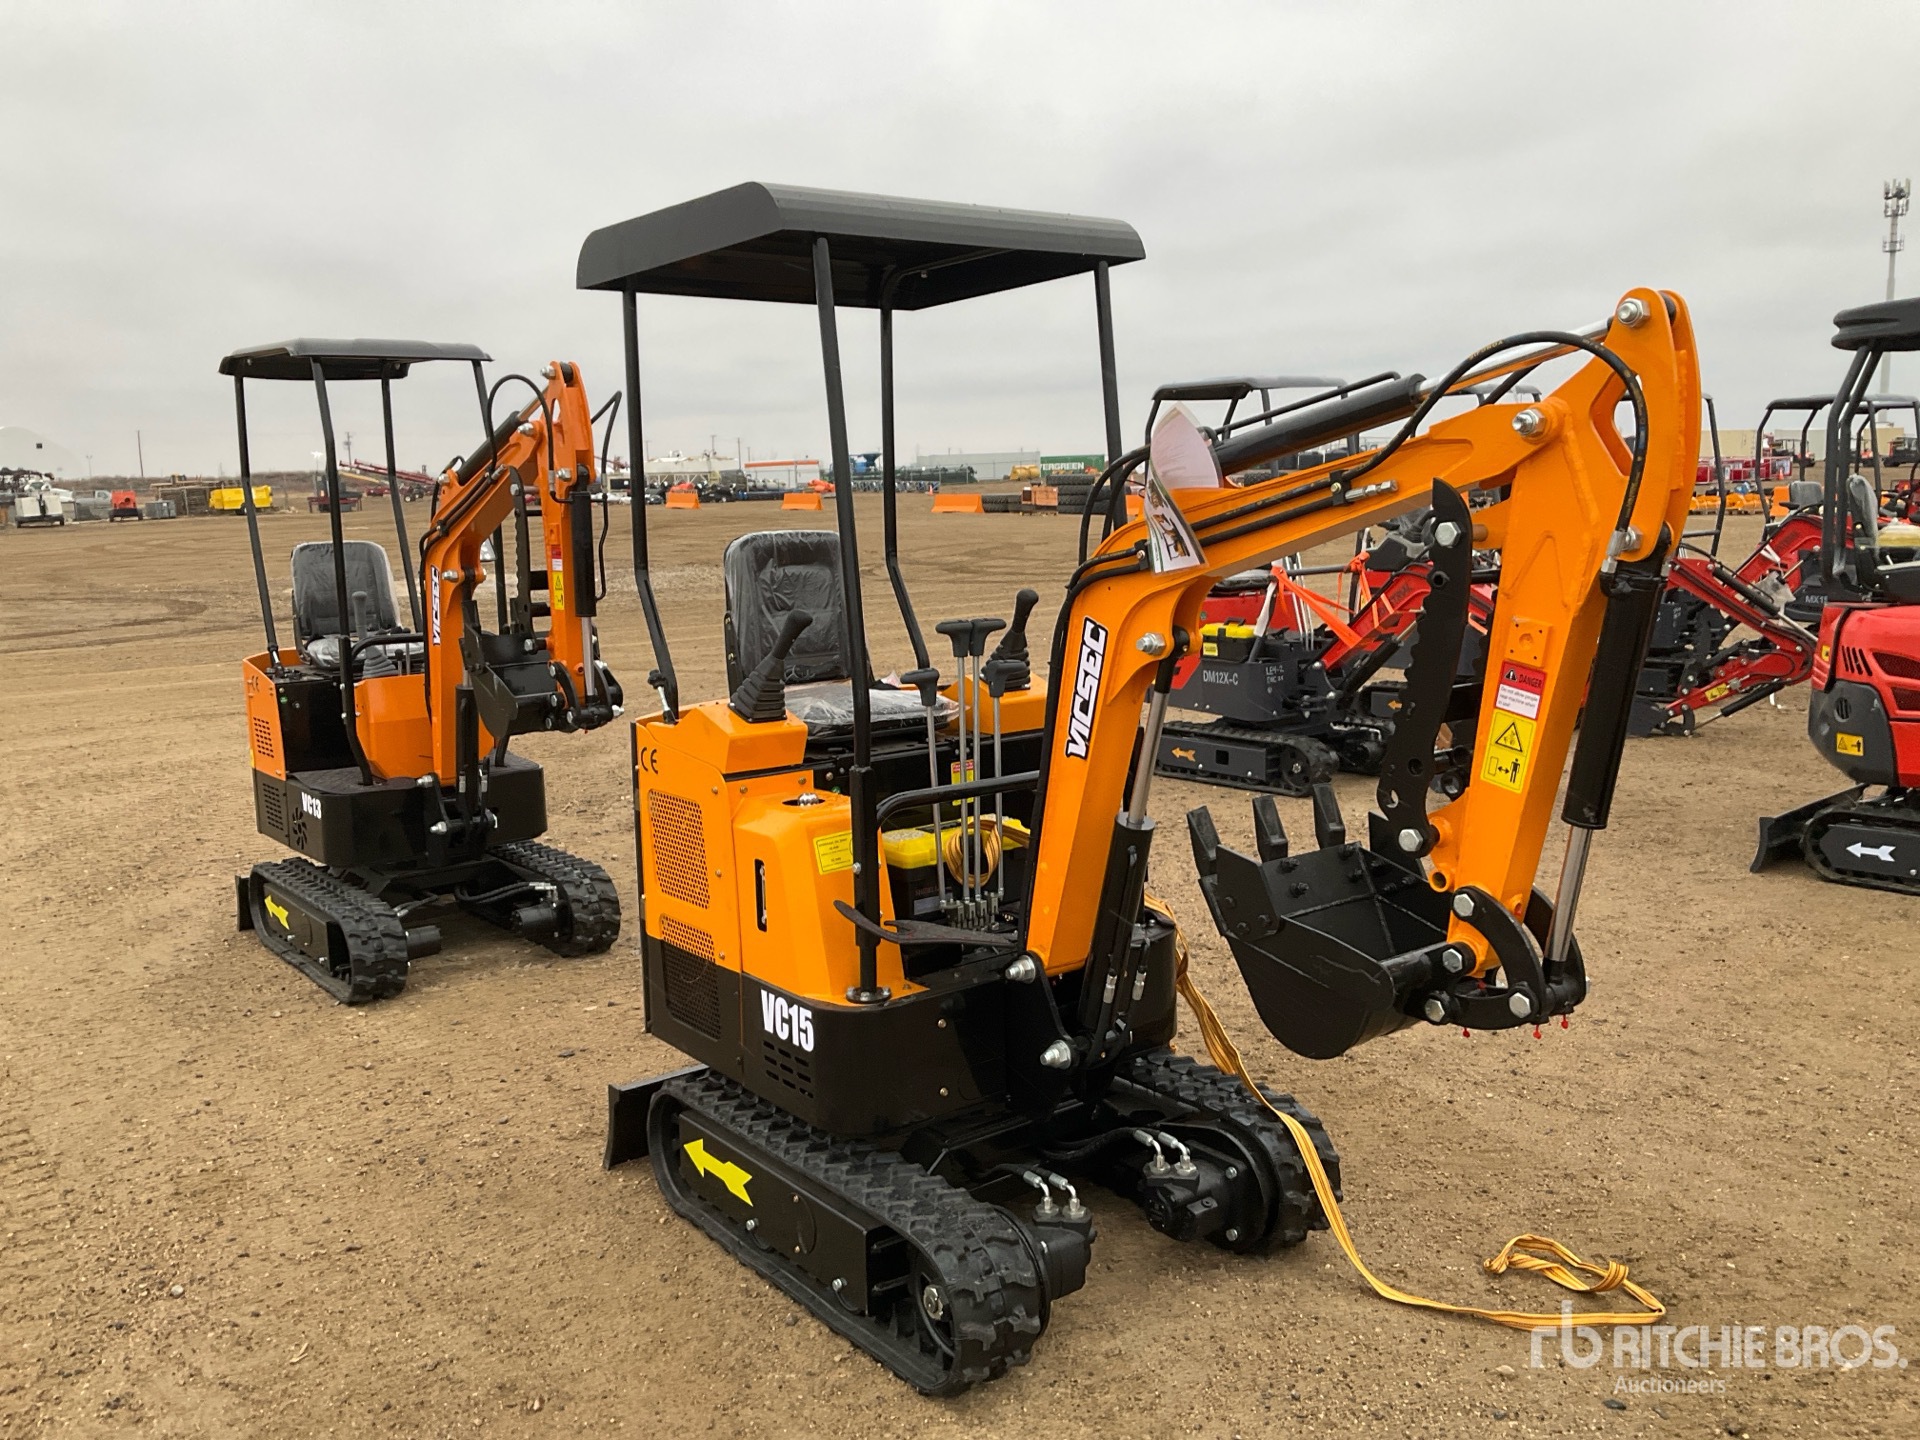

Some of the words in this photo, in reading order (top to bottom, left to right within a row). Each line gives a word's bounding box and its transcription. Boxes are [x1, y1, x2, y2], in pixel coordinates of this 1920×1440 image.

[431, 565, 441, 646] VICSEC
[1066, 617, 1108, 759] VICSEC
[1203, 670, 1239, 685] DM12X-C
[1518, 673, 1543, 688] DANGER
[301, 791, 322, 820] VC13
[760, 988, 815, 1053] VC15
